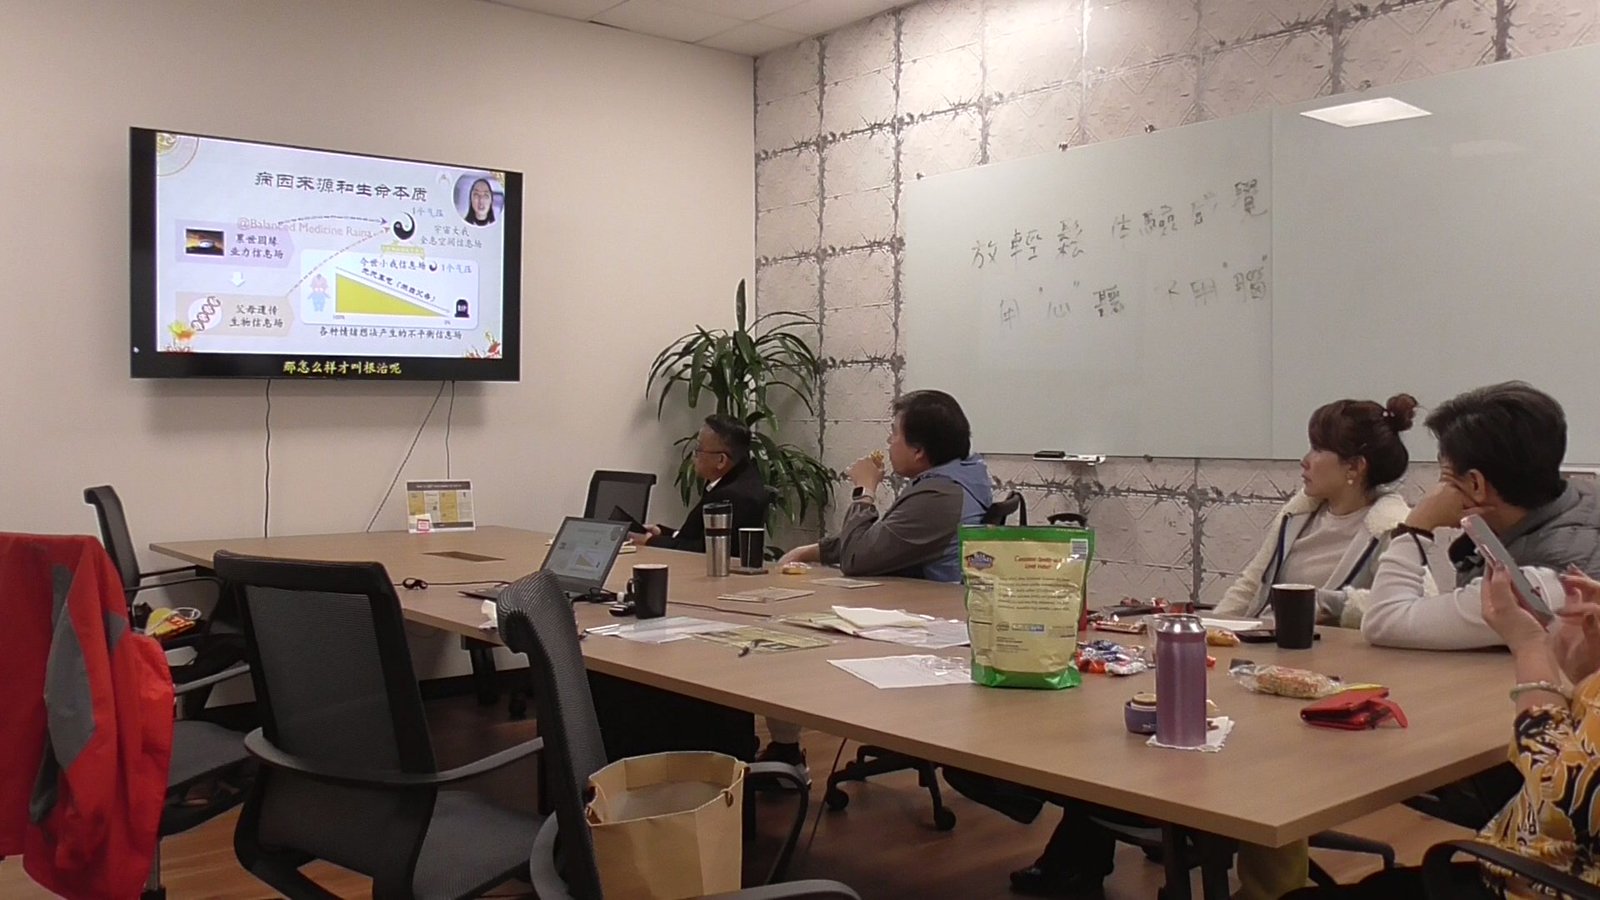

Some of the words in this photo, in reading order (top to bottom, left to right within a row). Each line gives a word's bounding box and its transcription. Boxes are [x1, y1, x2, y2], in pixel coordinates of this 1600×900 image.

[254, 171, 428, 202] 病因来源和生命本质
[282, 360, 402, 375] 那怎么样才叫根治呢
